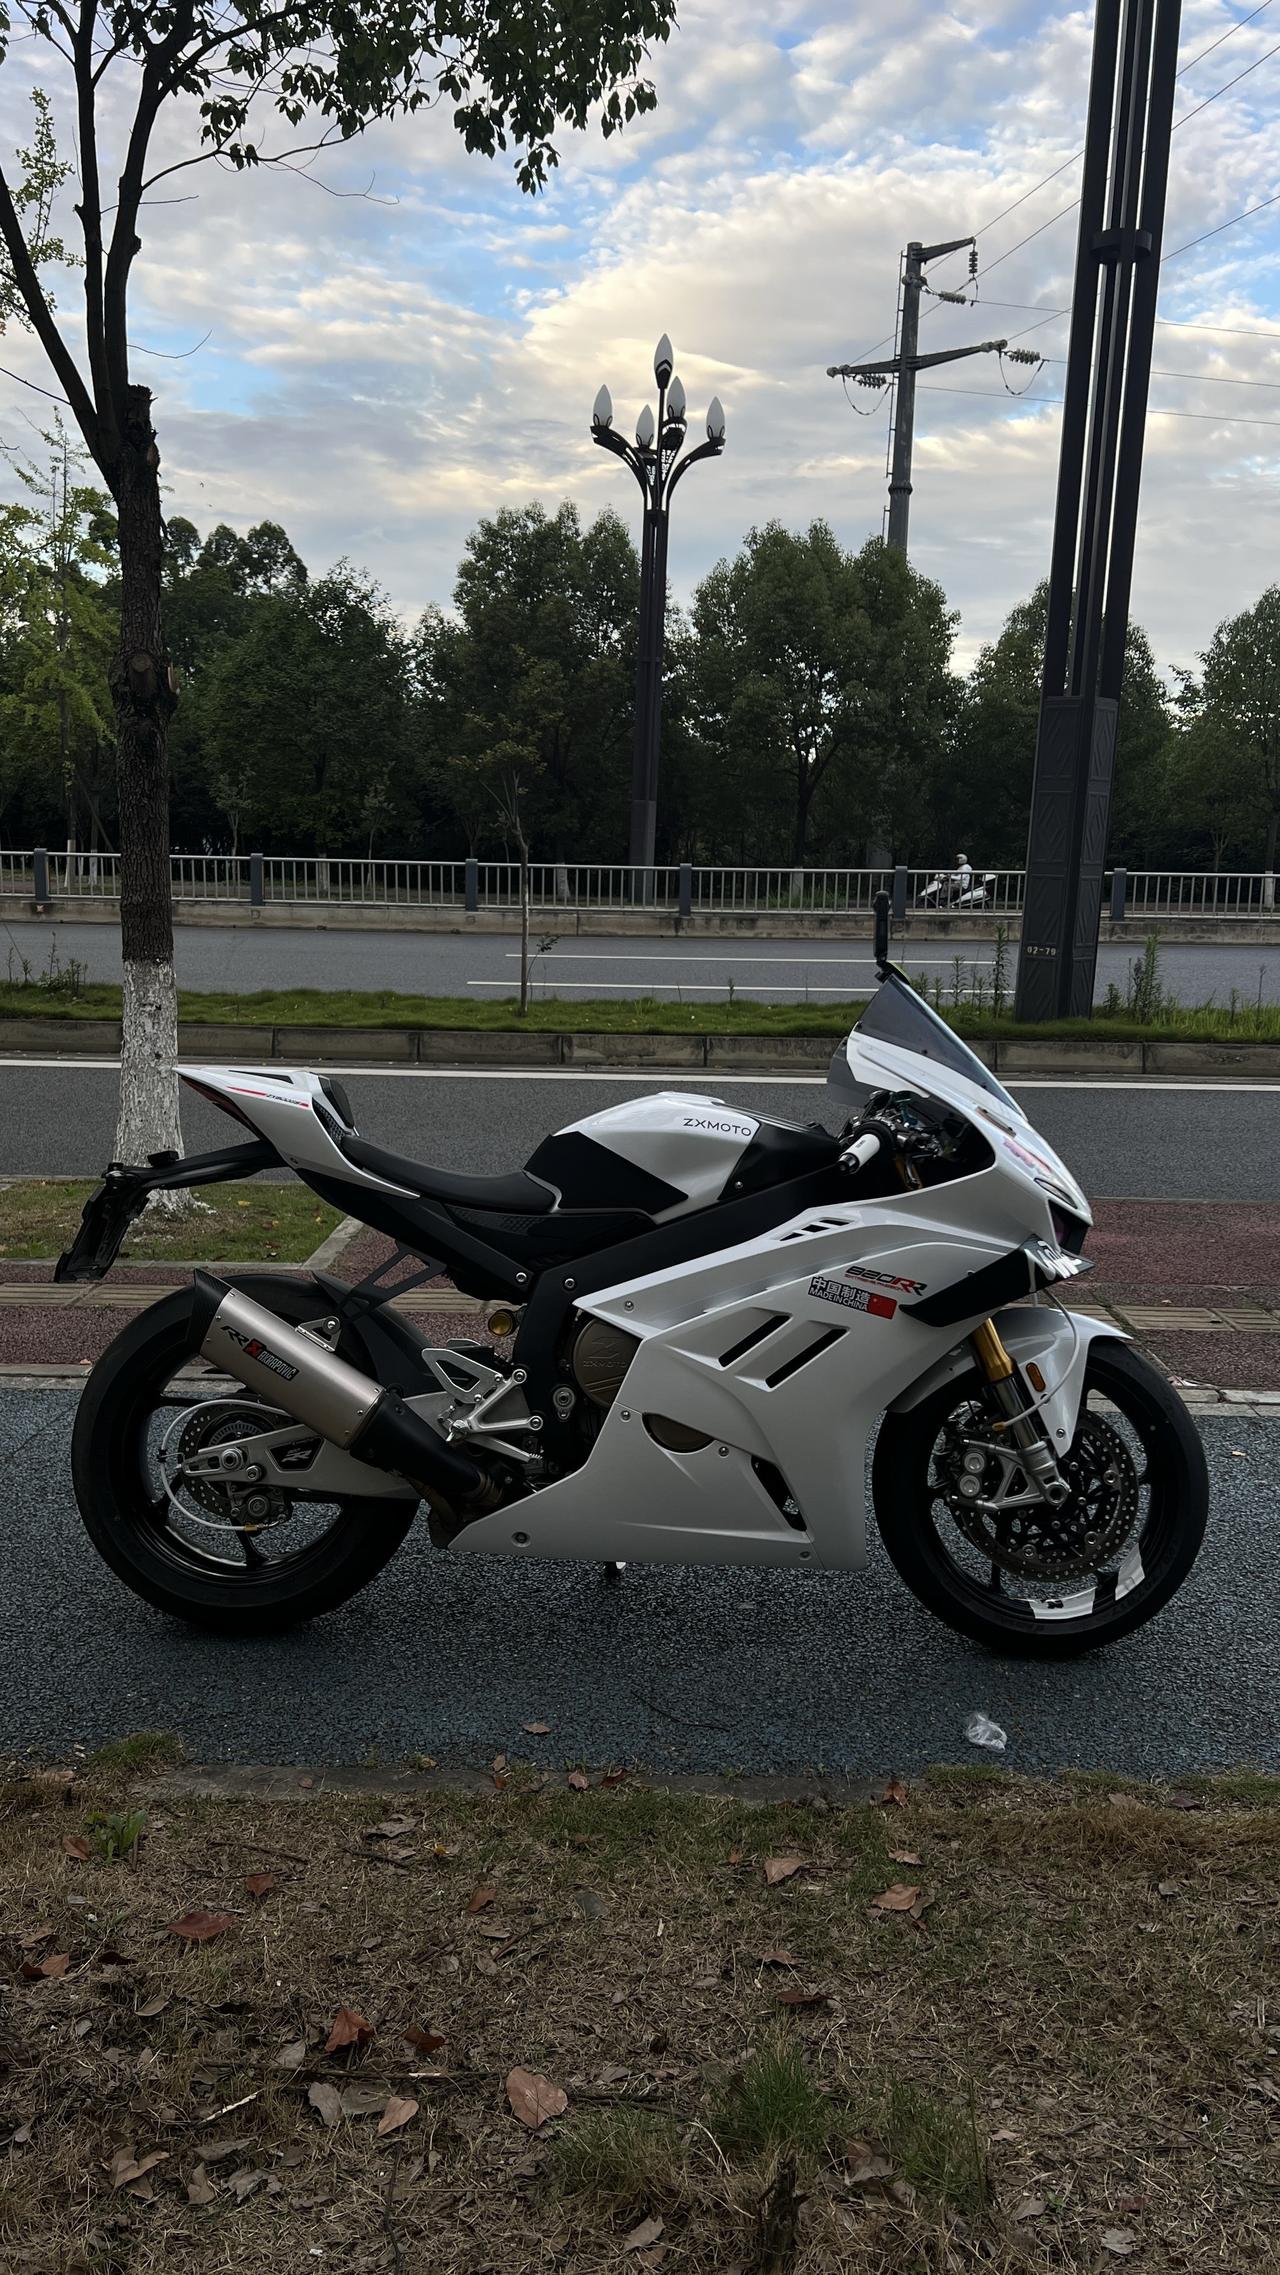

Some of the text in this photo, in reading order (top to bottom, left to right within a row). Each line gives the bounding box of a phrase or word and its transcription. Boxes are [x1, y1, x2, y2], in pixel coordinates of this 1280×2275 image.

[683, 1118, 751, 1136] ZXMOTO
[812, 1277, 871, 1304] 中国制造
[845, 1265, 928, 1296] 820RR
[809, 1287, 868, 1311] MADE IN CHINA
